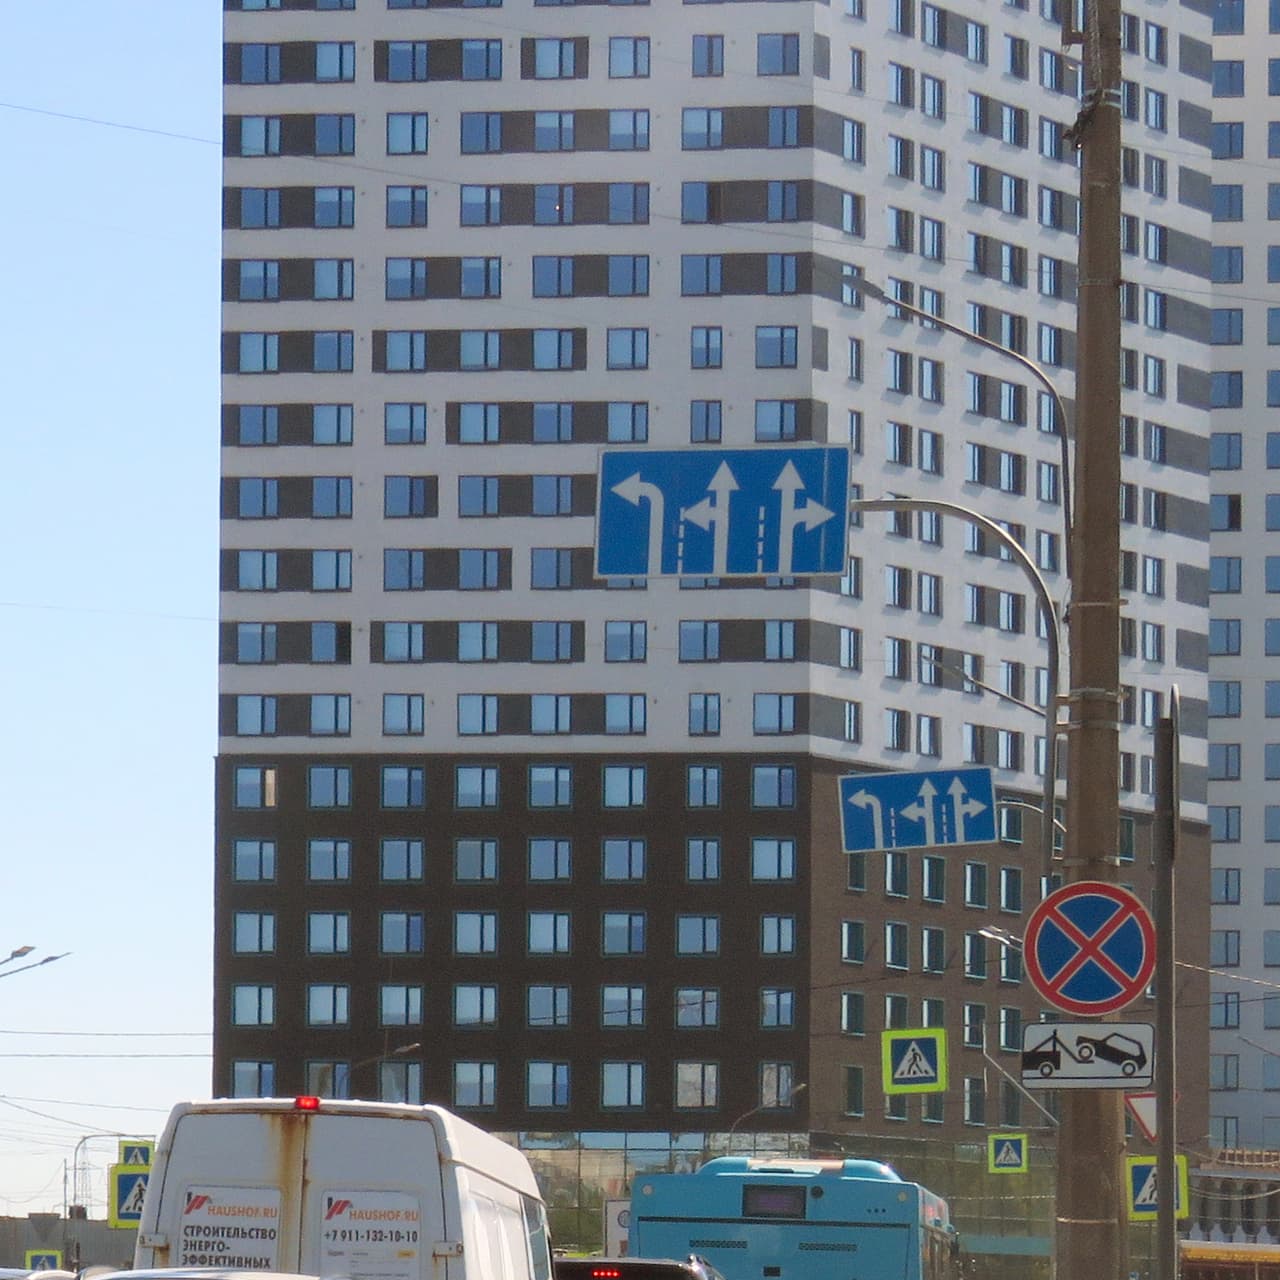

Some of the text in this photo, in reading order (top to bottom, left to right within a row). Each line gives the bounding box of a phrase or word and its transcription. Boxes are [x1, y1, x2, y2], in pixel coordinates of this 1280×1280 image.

[207, 1205, 278, 1218] HAUSHOF.RU
[349, 1210, 418, 1222] HAUSHOF.RU
[183, 1225, 277, 1241] СТРОИТЕЛЬСТВО
[324, 1230, 418, 1243] +7 911-132-10-10
[182, 1240, 231, 1252] ЭНЕРГО-
[182, 1254, 271, 1269] ЭФФЕКТИВНЫХ
